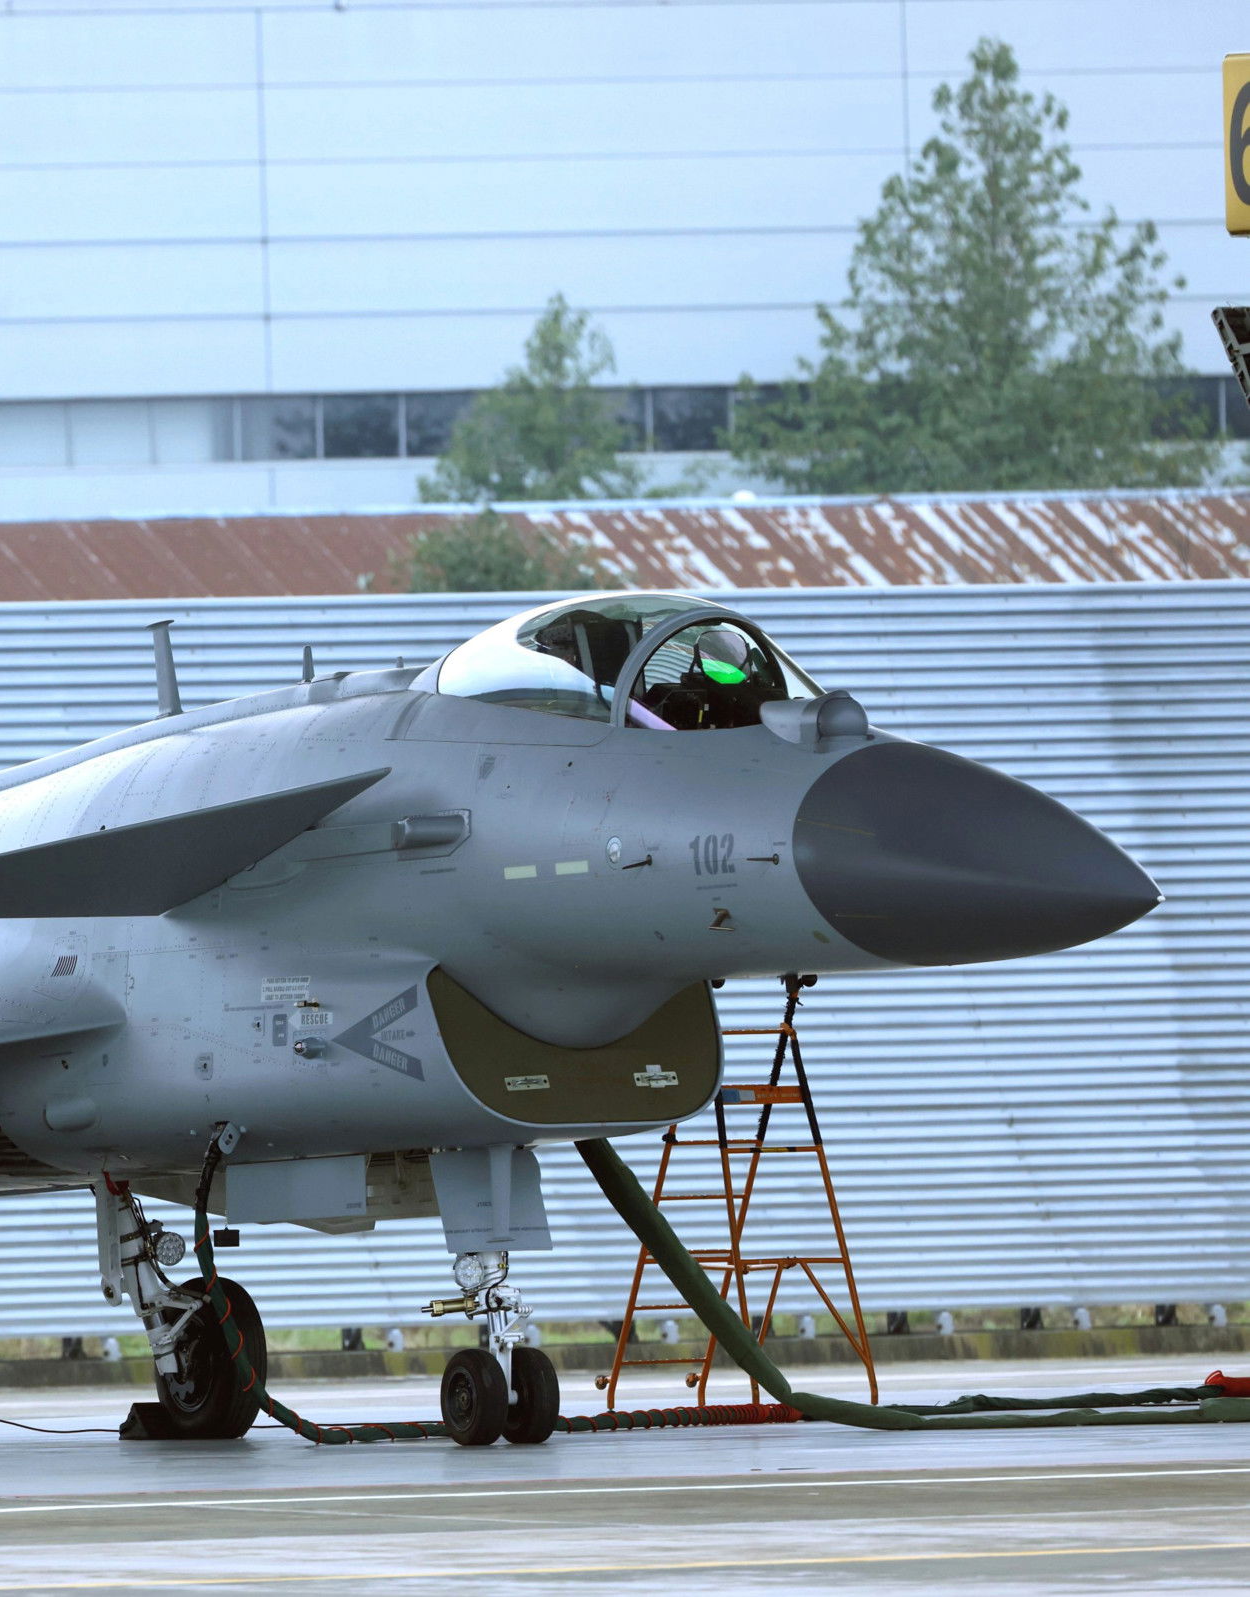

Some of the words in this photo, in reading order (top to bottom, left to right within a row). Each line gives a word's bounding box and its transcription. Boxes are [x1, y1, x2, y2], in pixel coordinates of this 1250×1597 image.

[689, 833, 736, 876] 102
[301, 1013, 328, 1025] RESCUE
[372, 998, 406, 1030] DANGER
[373, 1043, 408, 1073] DANGER
